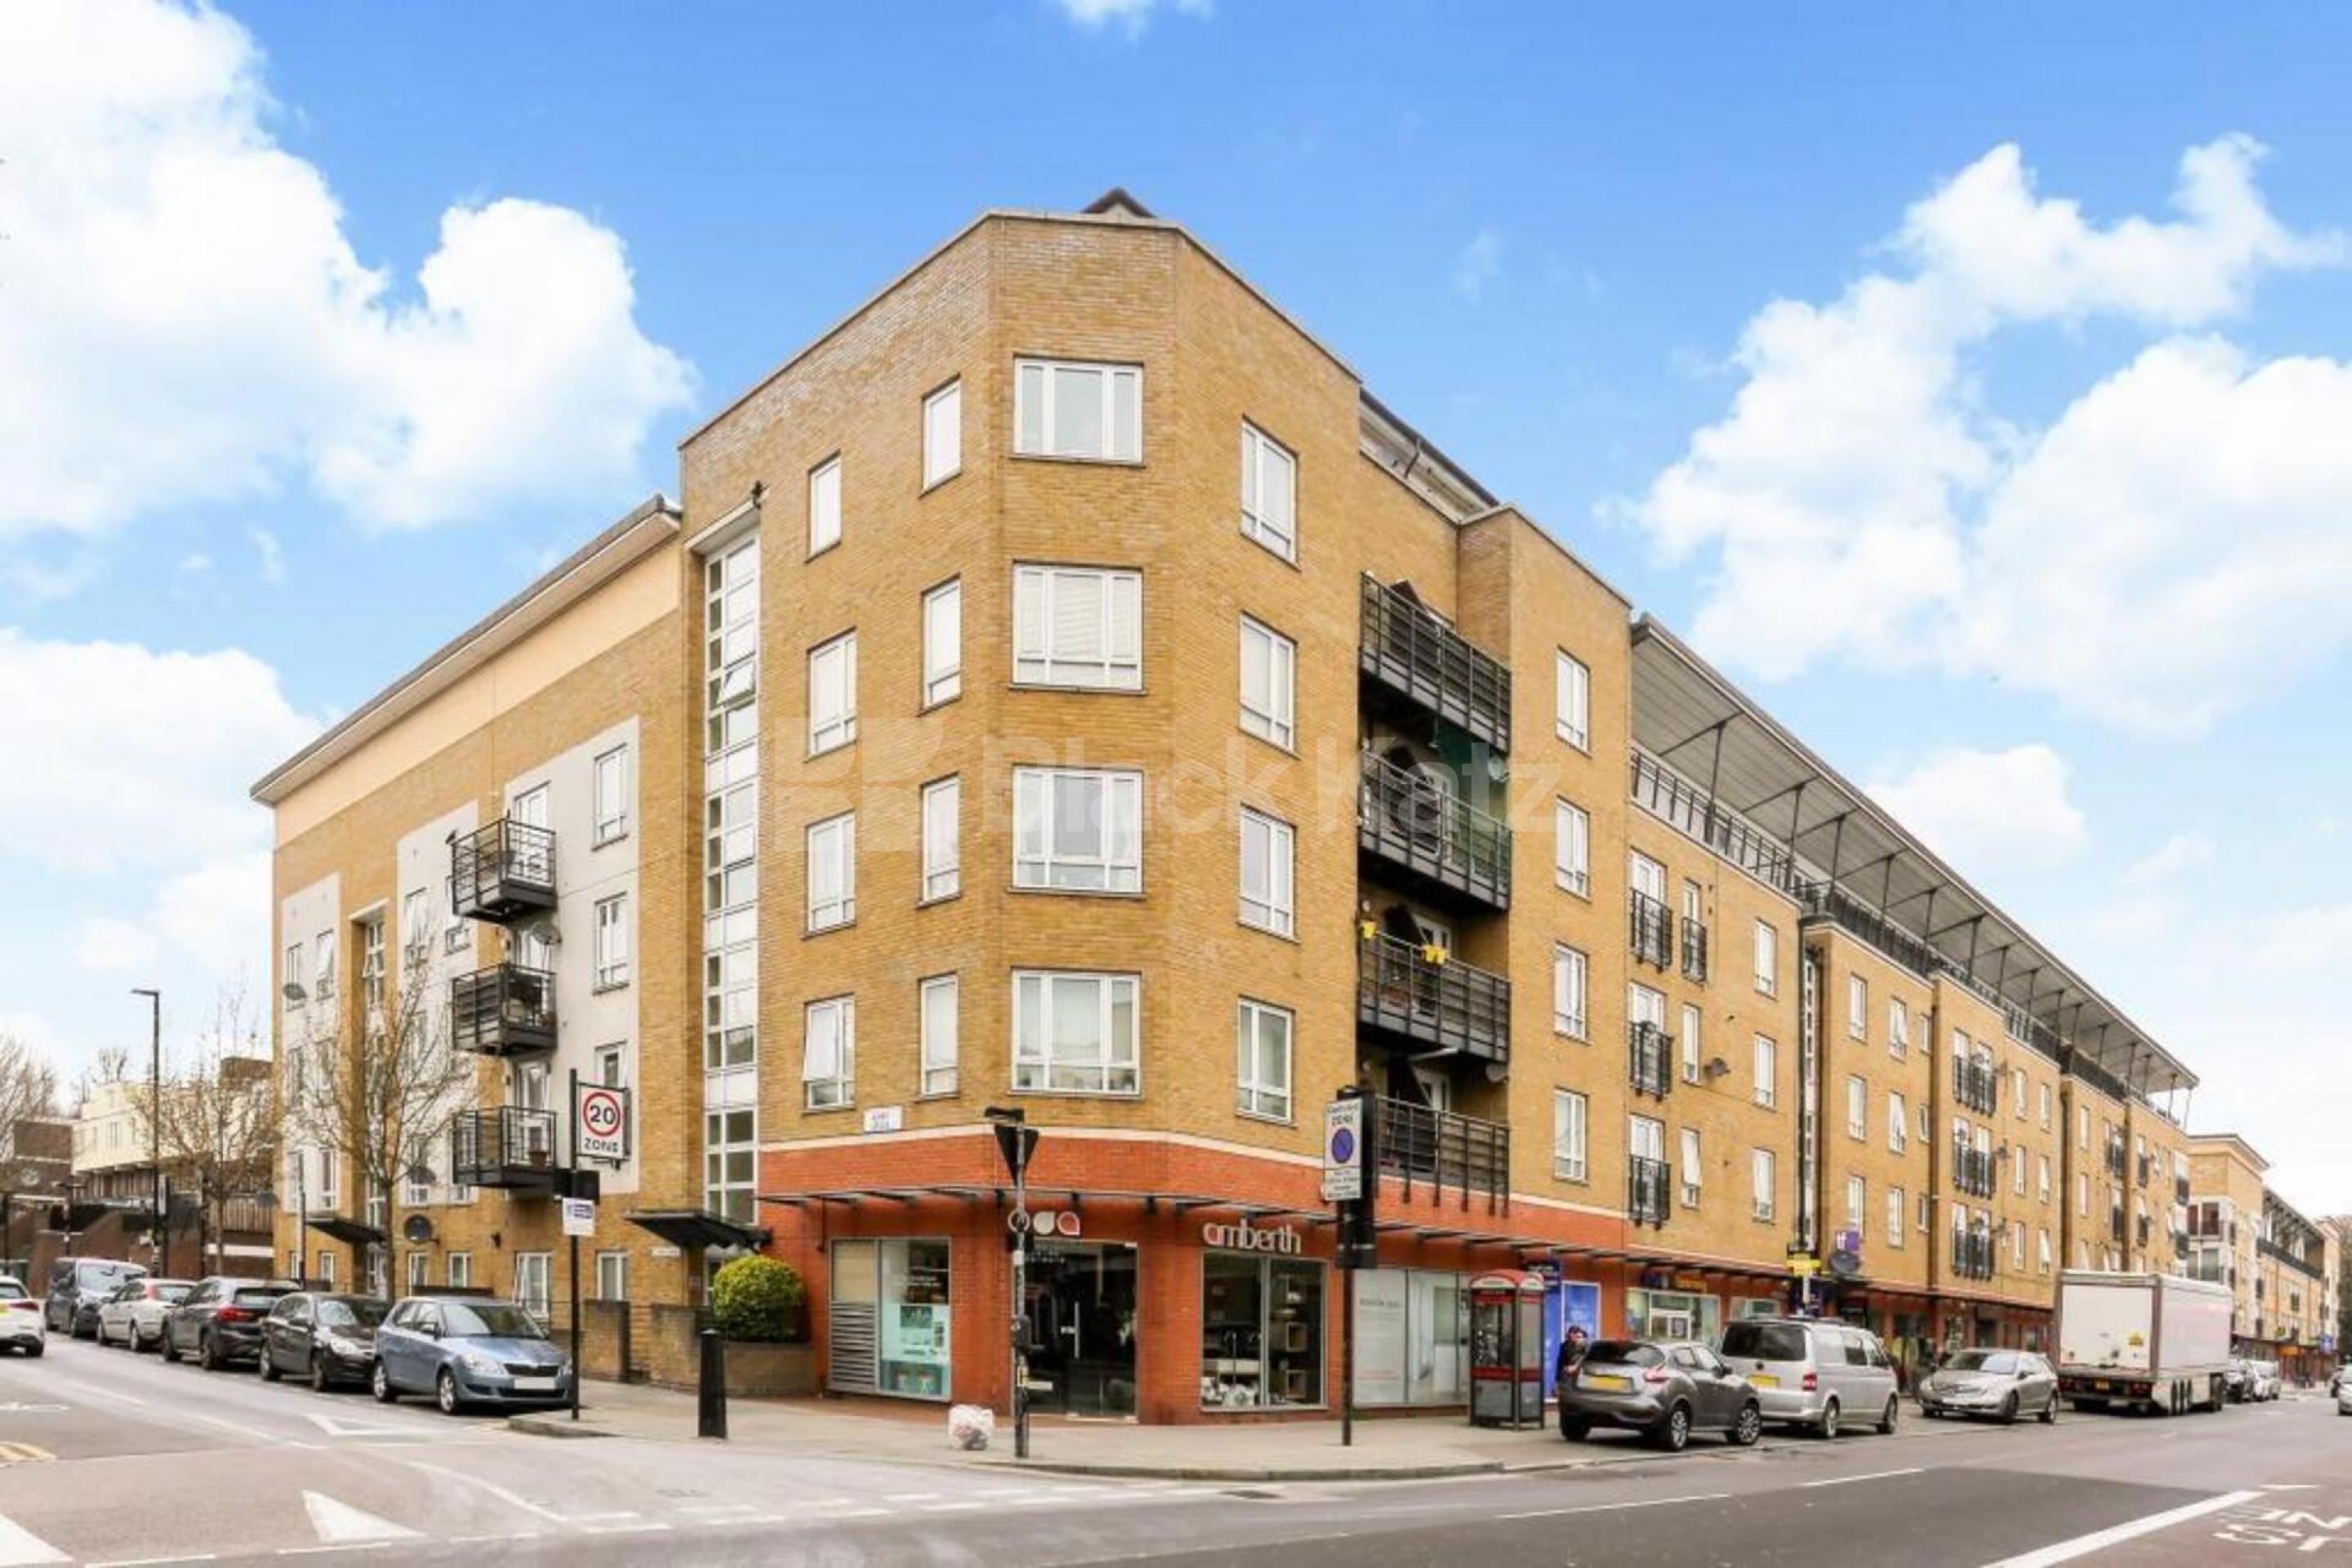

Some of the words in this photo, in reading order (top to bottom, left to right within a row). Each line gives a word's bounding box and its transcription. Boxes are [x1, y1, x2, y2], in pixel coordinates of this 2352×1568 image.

[590, 1104, 617, 1125] 20
[584, 1137, 619, 1153] ZONE
[1202, 1216, 1302, 1254] amberth
